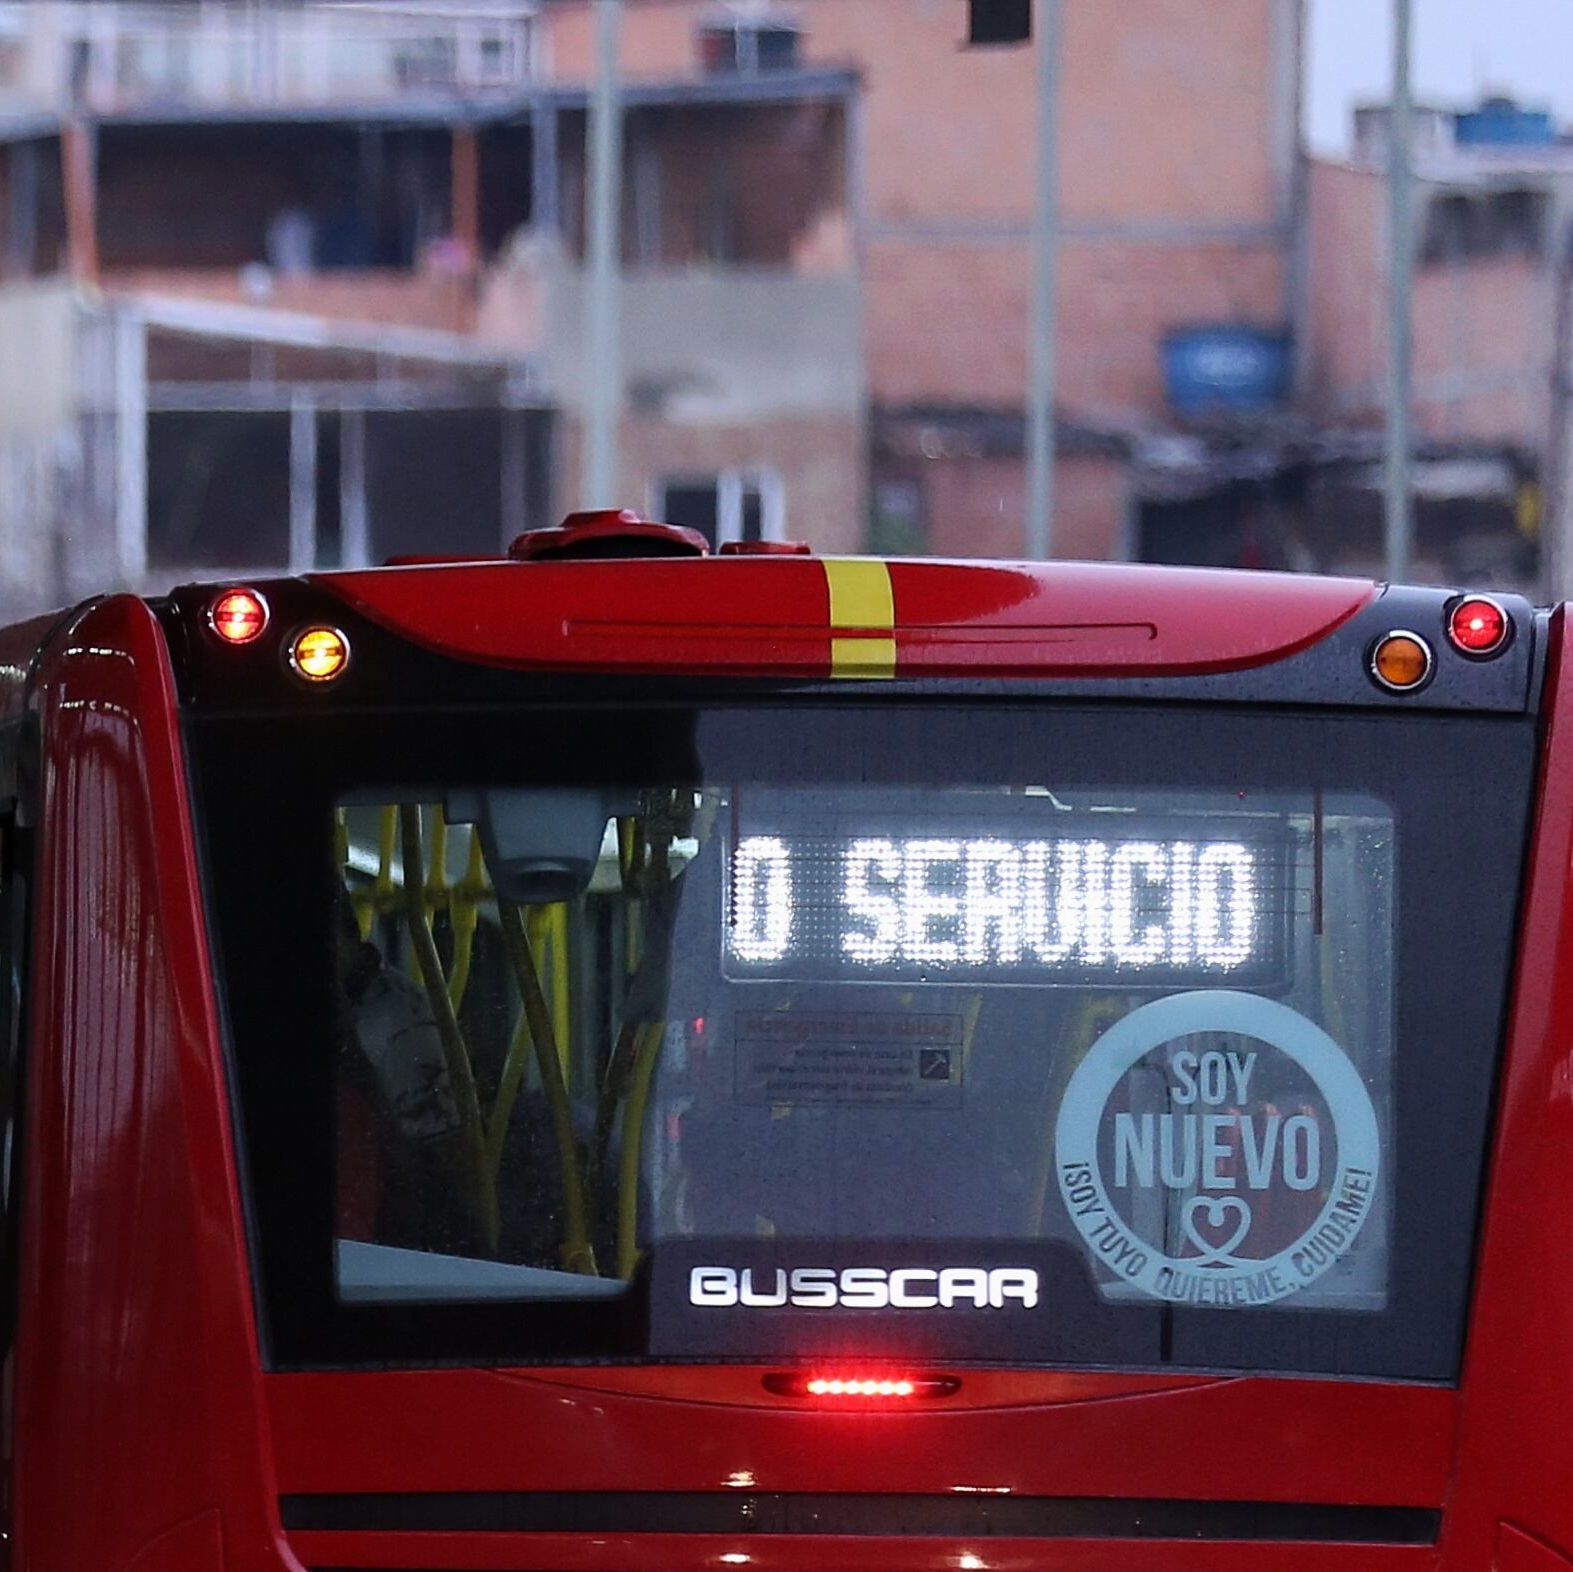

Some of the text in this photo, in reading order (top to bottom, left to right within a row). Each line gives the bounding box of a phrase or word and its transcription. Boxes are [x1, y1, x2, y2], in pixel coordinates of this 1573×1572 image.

[843, 838, 1255, 967] SERVICIO
[1171, 1051, 1257, 1105] SOY
[1114, 1113, 1321, 1191] NUEVO
[1090, 1216, 1148, 1278] TUYO
[689, 1266, 1039, 1309] BUSSCAR
